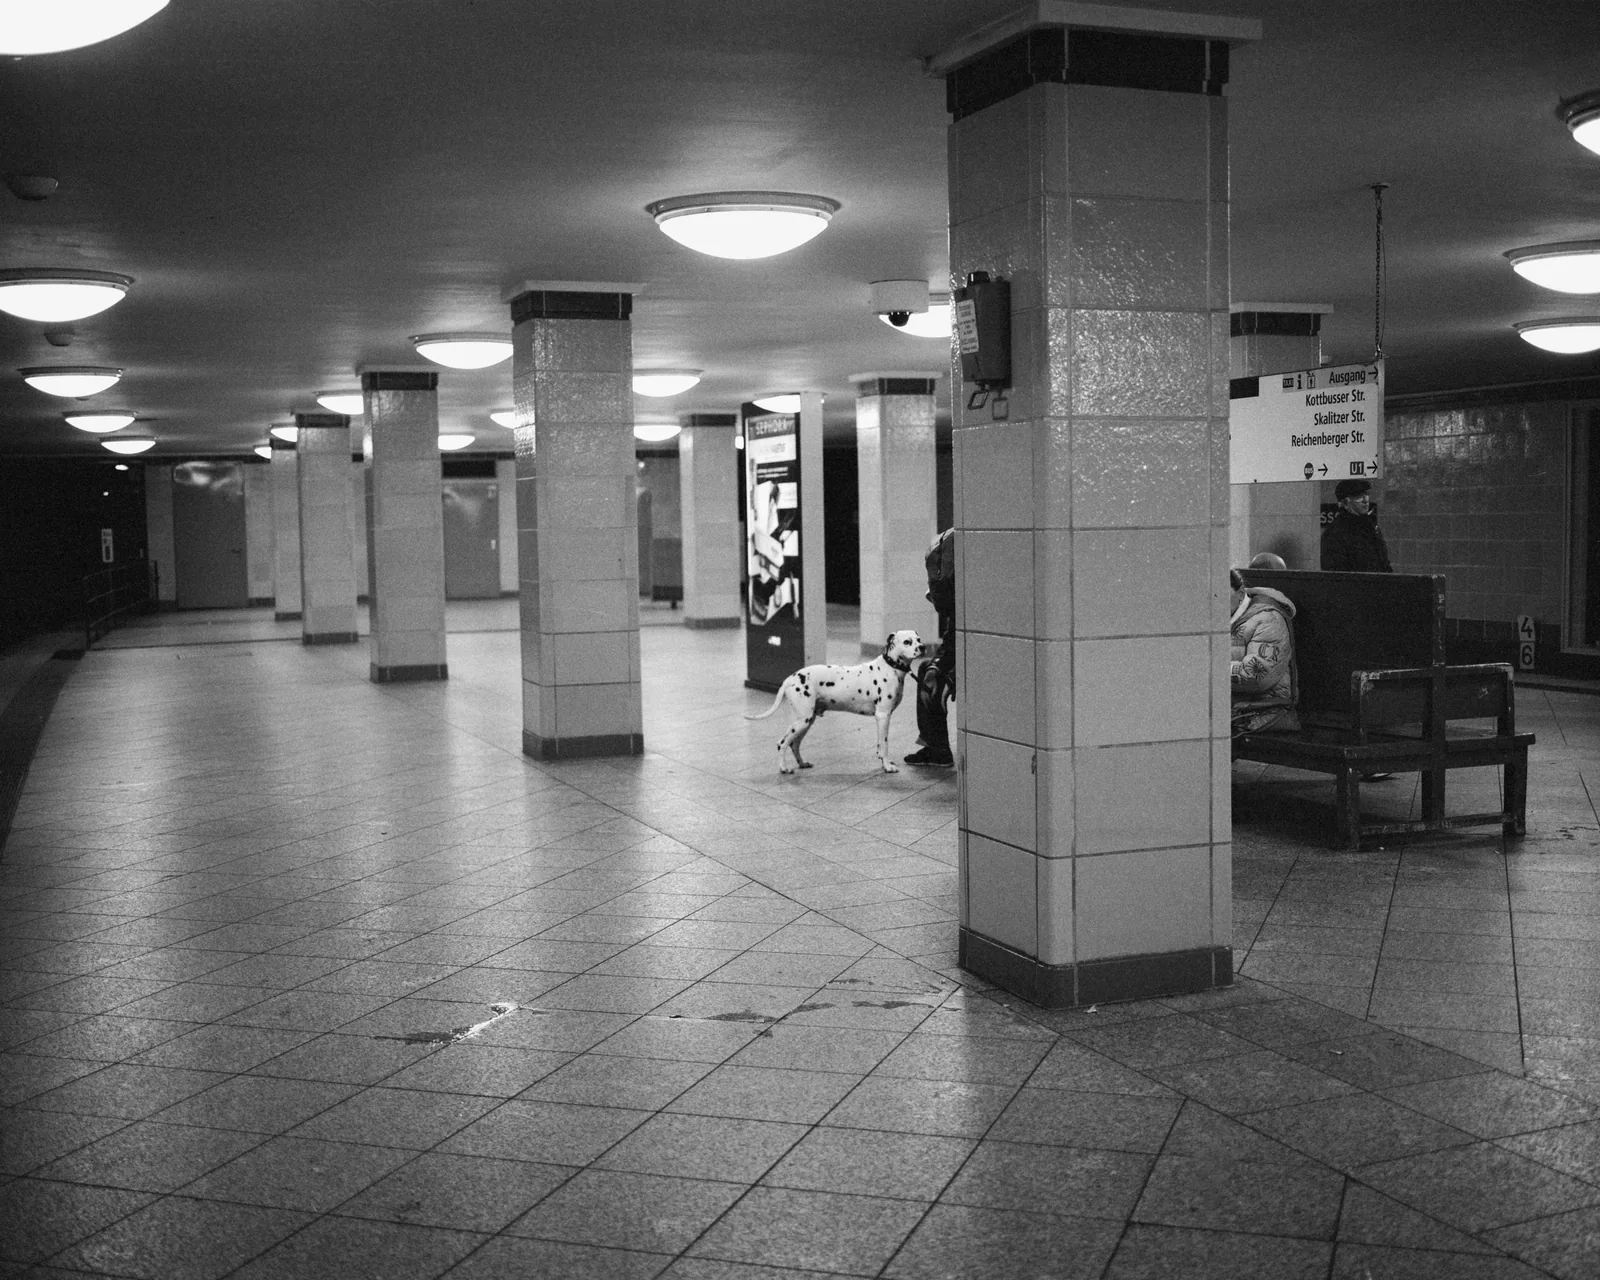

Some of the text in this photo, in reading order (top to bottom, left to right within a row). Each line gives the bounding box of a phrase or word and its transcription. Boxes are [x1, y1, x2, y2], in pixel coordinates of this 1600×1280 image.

[1329, 370, 1366, 386] Ausgang
[1305, 389, 1366, 407] Kottbusser Str.
[1314, 410, 1365, 426] Skalitzer Str.
[1291, 430, 1365, 447] Reichenberger Str.
[1351, 463, 1362, 474] U1
[1520, 616, 1533, 638] 4
[1522, 645, 1533, 665] 6
